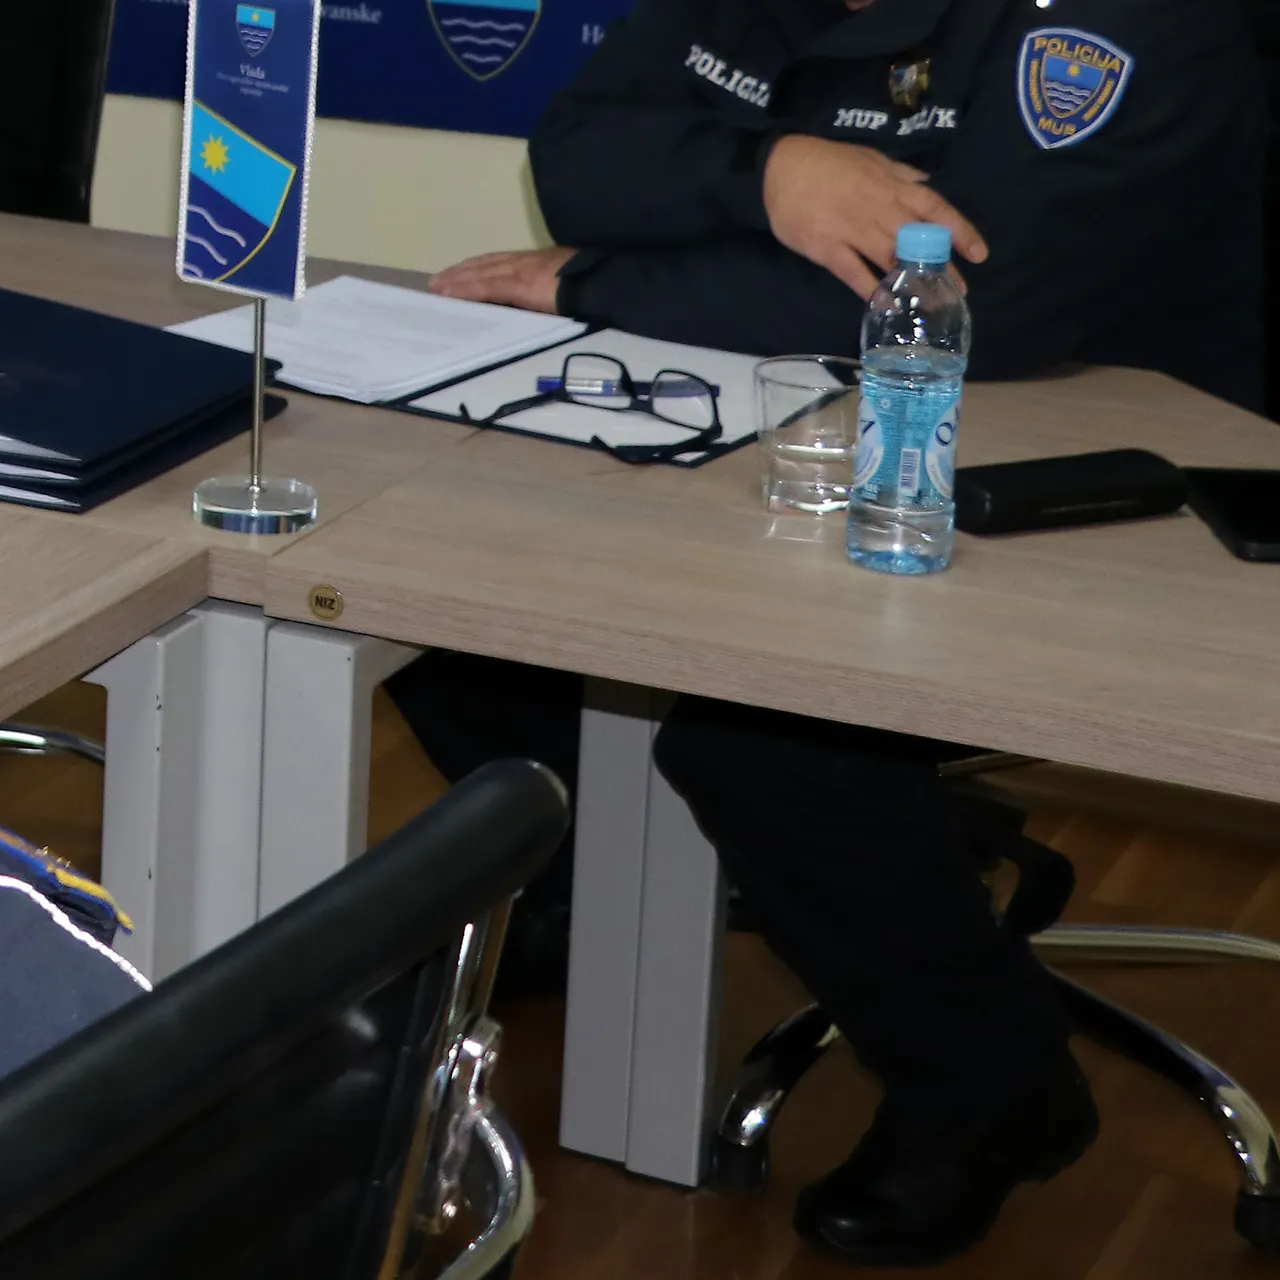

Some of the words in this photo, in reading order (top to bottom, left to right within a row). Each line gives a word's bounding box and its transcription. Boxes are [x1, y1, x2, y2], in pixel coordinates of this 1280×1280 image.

[1034, 36, 1122, 73] POLICIJA
[833, 107, 890, 131] MUP
[1038, 115, 1077, 136] MUP
